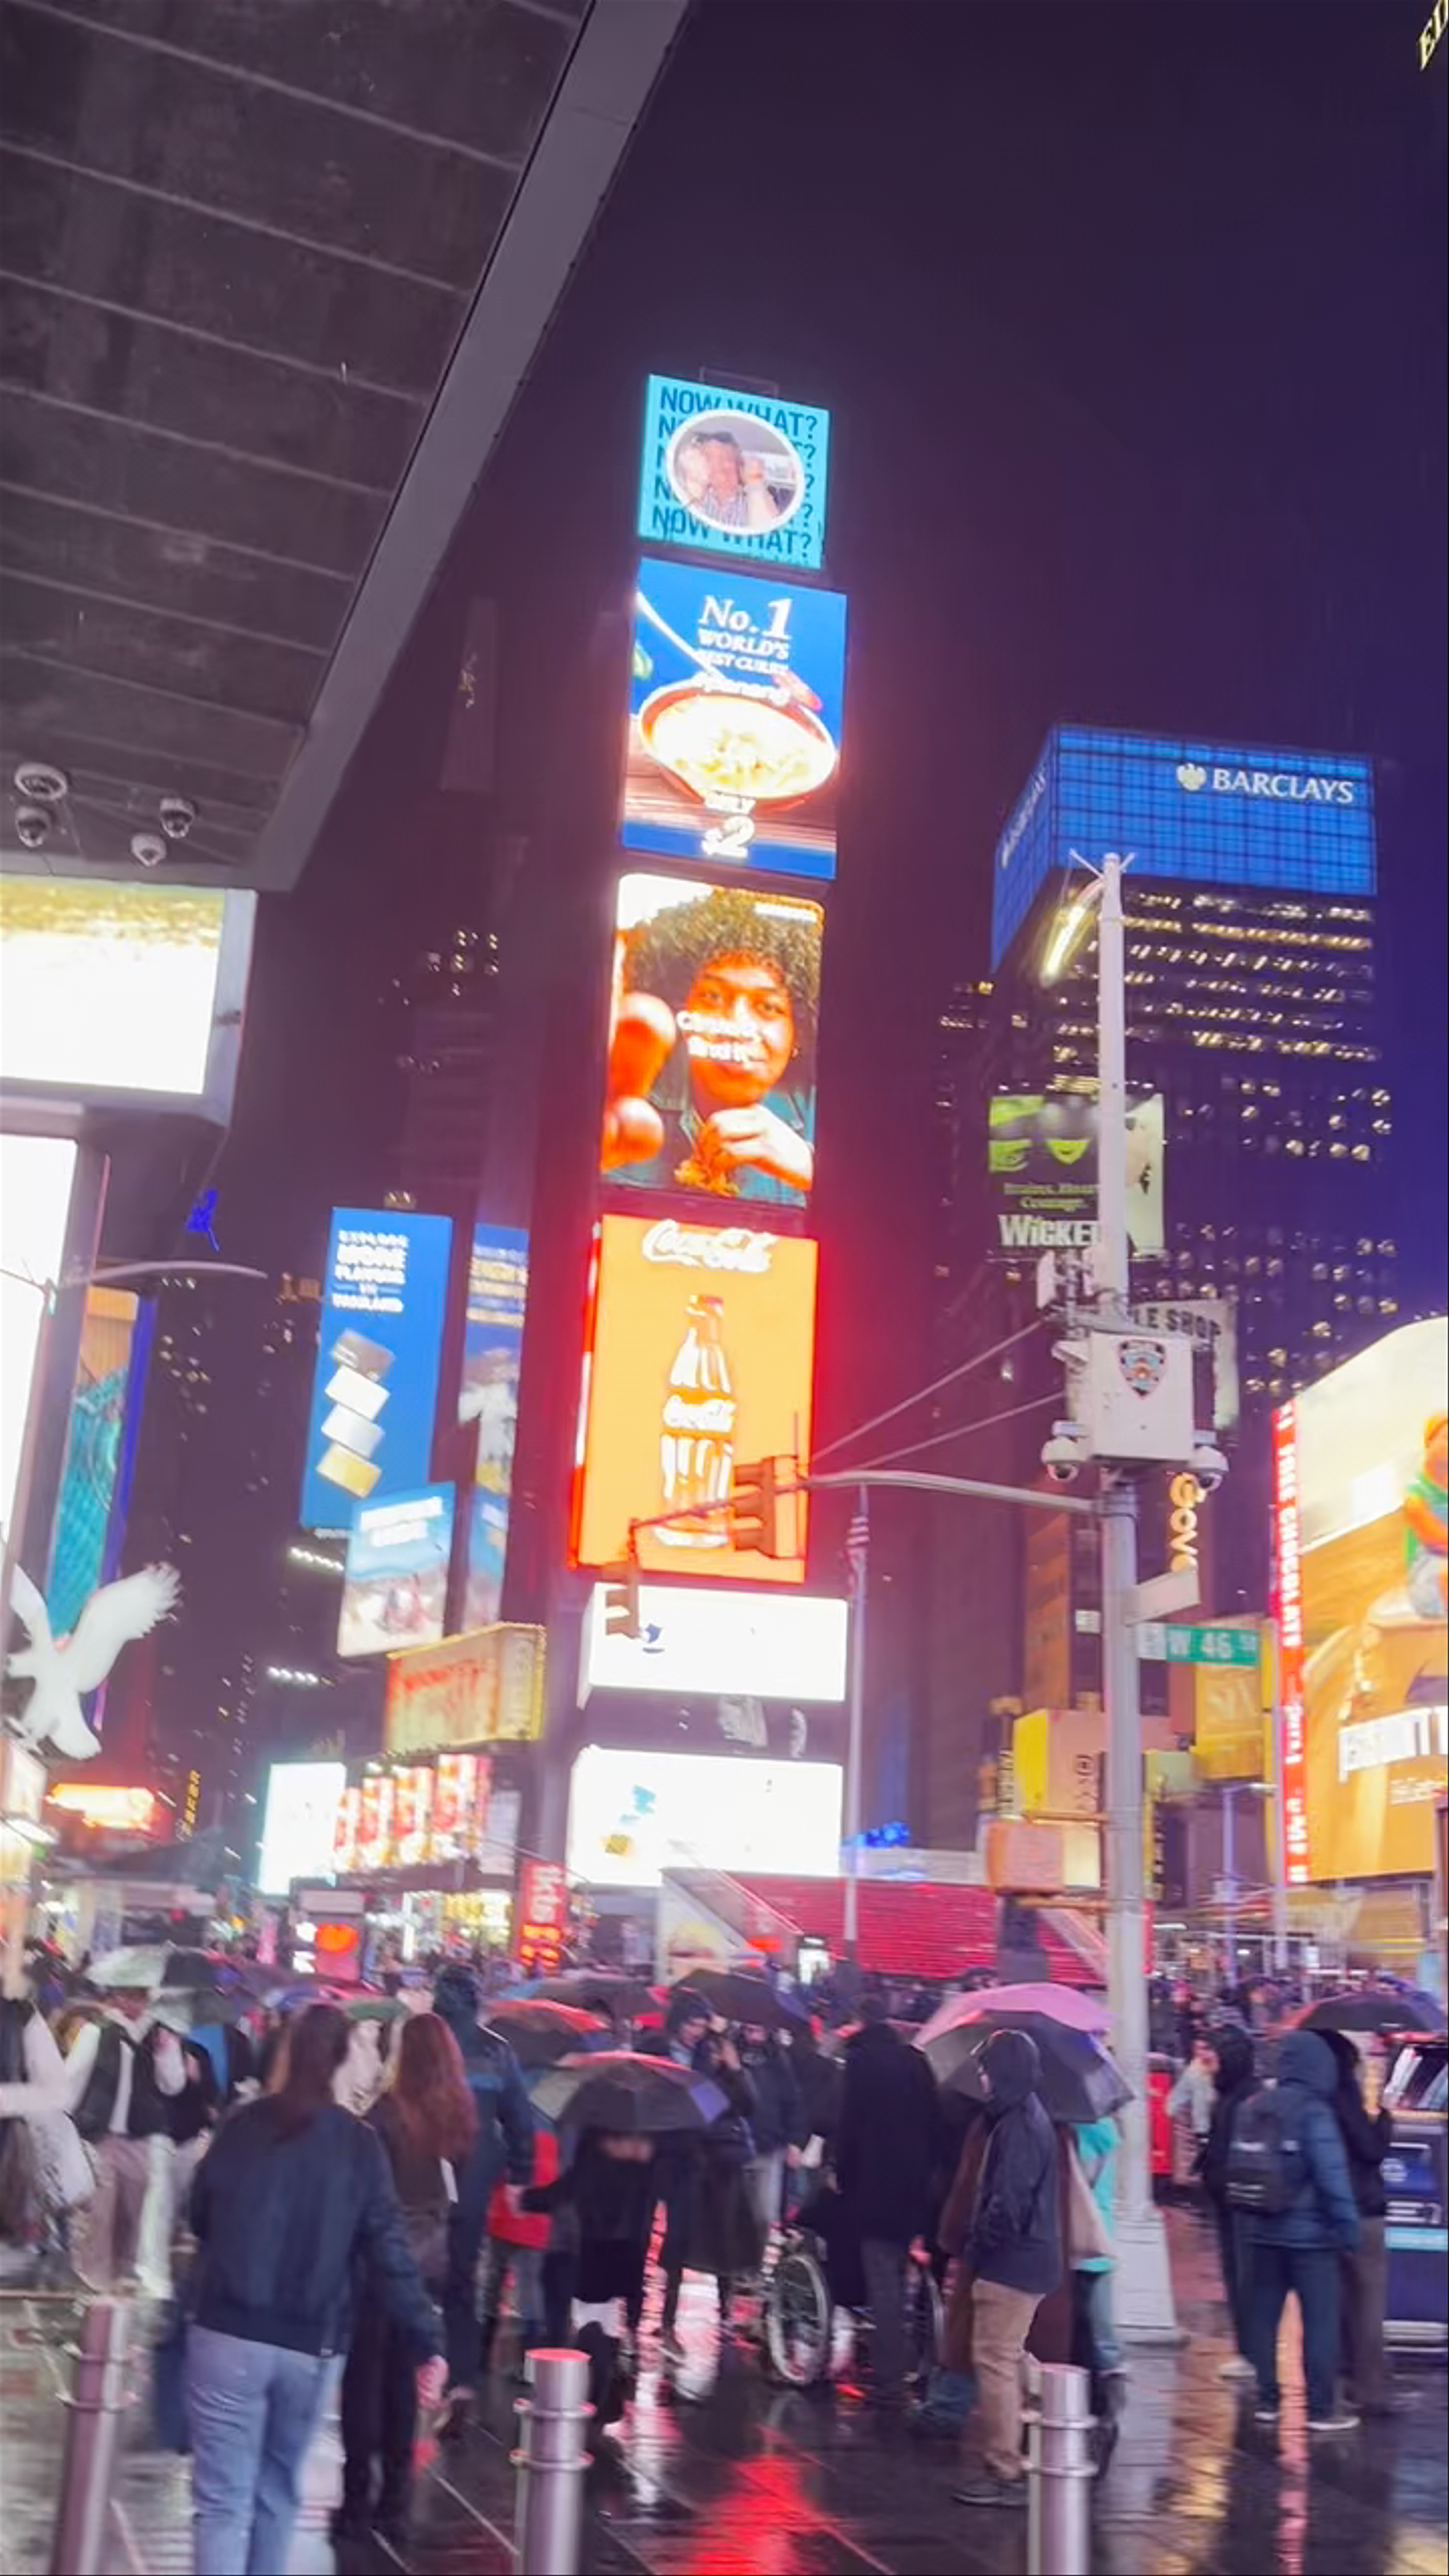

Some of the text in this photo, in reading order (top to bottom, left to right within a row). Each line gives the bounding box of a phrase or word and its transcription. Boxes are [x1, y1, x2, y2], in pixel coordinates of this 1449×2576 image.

[1213, 768, 1354, 803] BARCLAYS
[997, 1214, 1099, 1247] WICKE
[1202, 1631, 1232, 1659] 46
